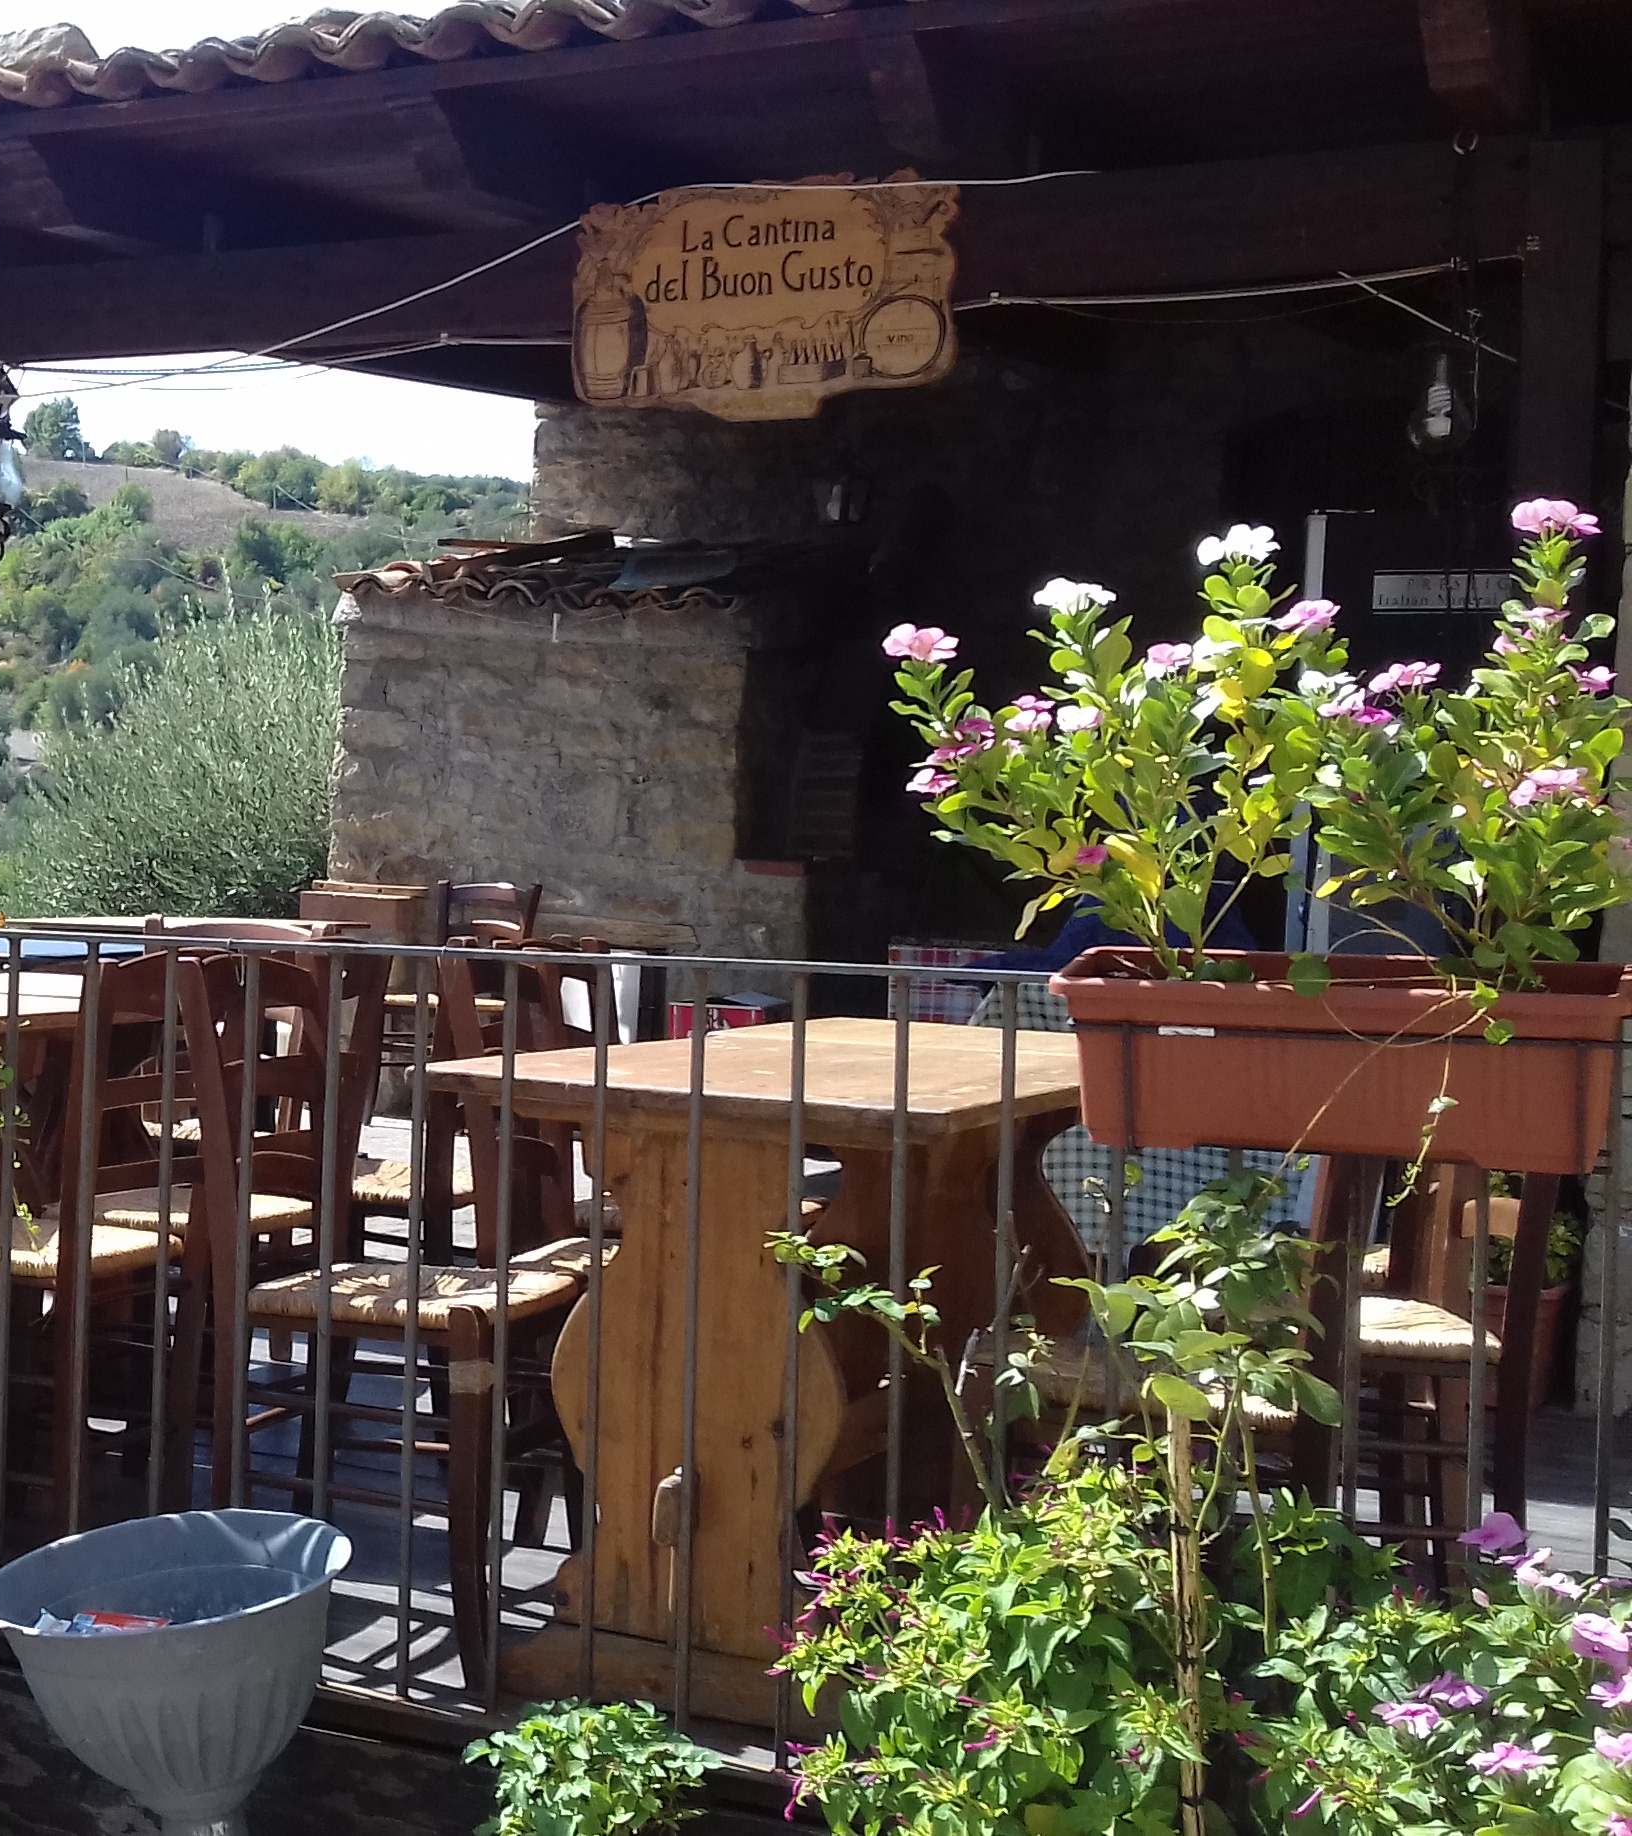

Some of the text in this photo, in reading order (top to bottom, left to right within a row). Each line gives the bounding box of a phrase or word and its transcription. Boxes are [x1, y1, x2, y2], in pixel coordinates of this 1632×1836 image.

[681, 214, 835, 254] La Cantina
[644, 250, 874, 303] del Buon Gusto
[886, 333, 915, 344] vino
